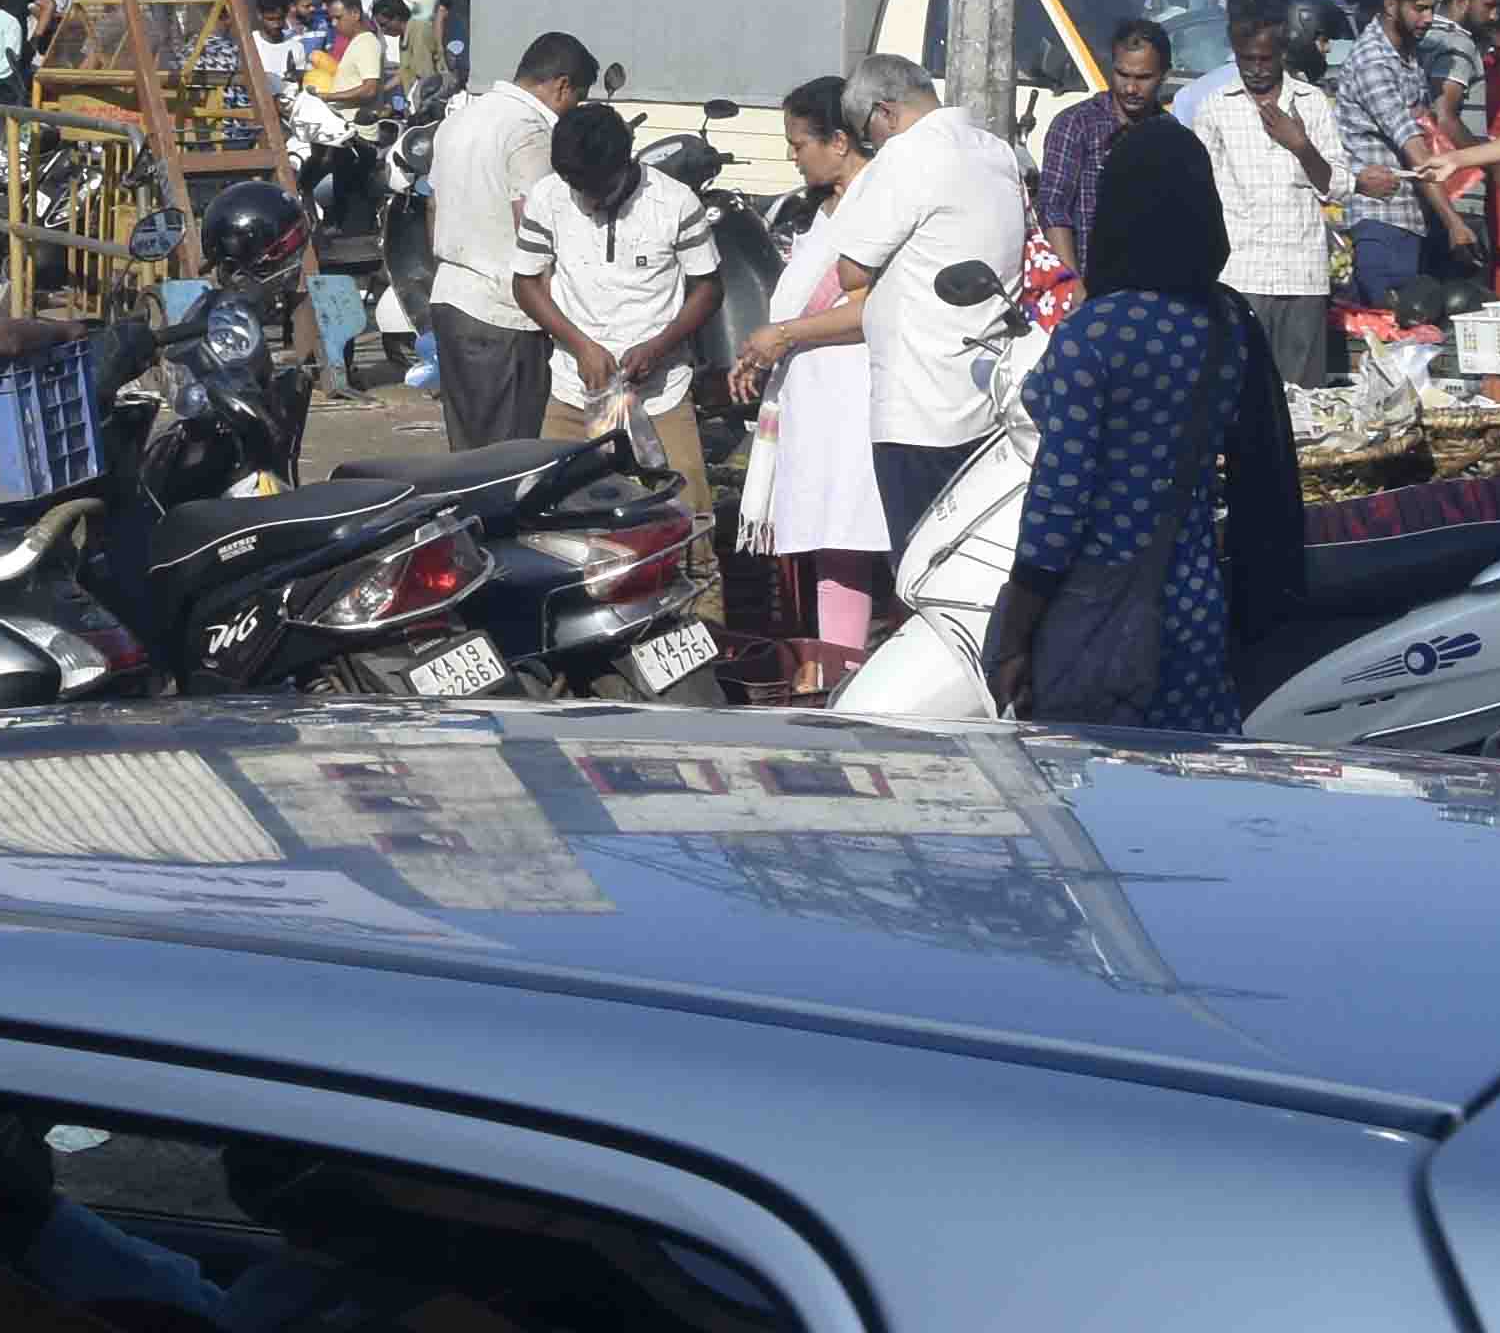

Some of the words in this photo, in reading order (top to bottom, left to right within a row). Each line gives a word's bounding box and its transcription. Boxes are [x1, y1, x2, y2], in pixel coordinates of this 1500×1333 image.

[428, 657, 456, 683] KA
[456, 644, 481, 668] 19
[651, 637, 674, 661] KA
